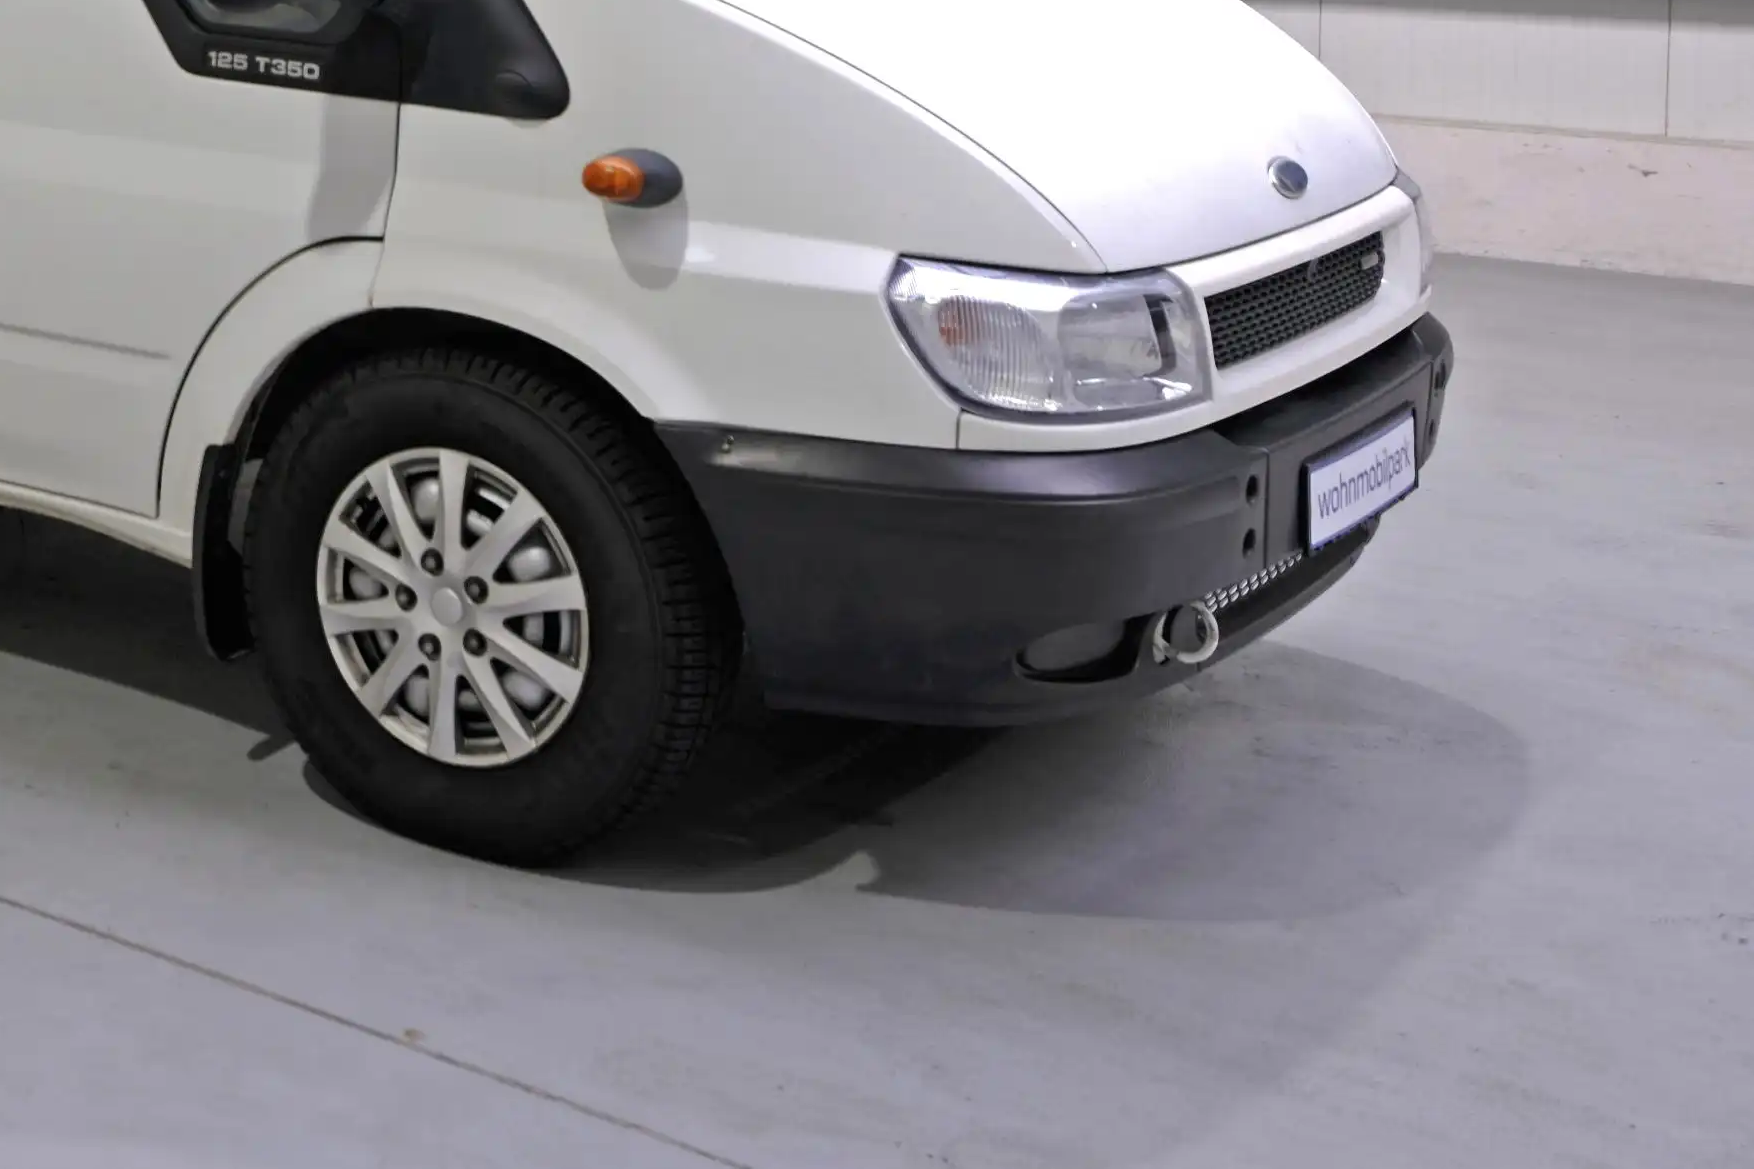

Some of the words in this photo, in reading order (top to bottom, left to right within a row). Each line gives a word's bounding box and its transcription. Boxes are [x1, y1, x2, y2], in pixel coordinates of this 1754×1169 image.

[208, 50, 248, 71] 125
[255, 56, 321, 80] T350
[1317, 435, 1412, 520] wohnmobilpark
